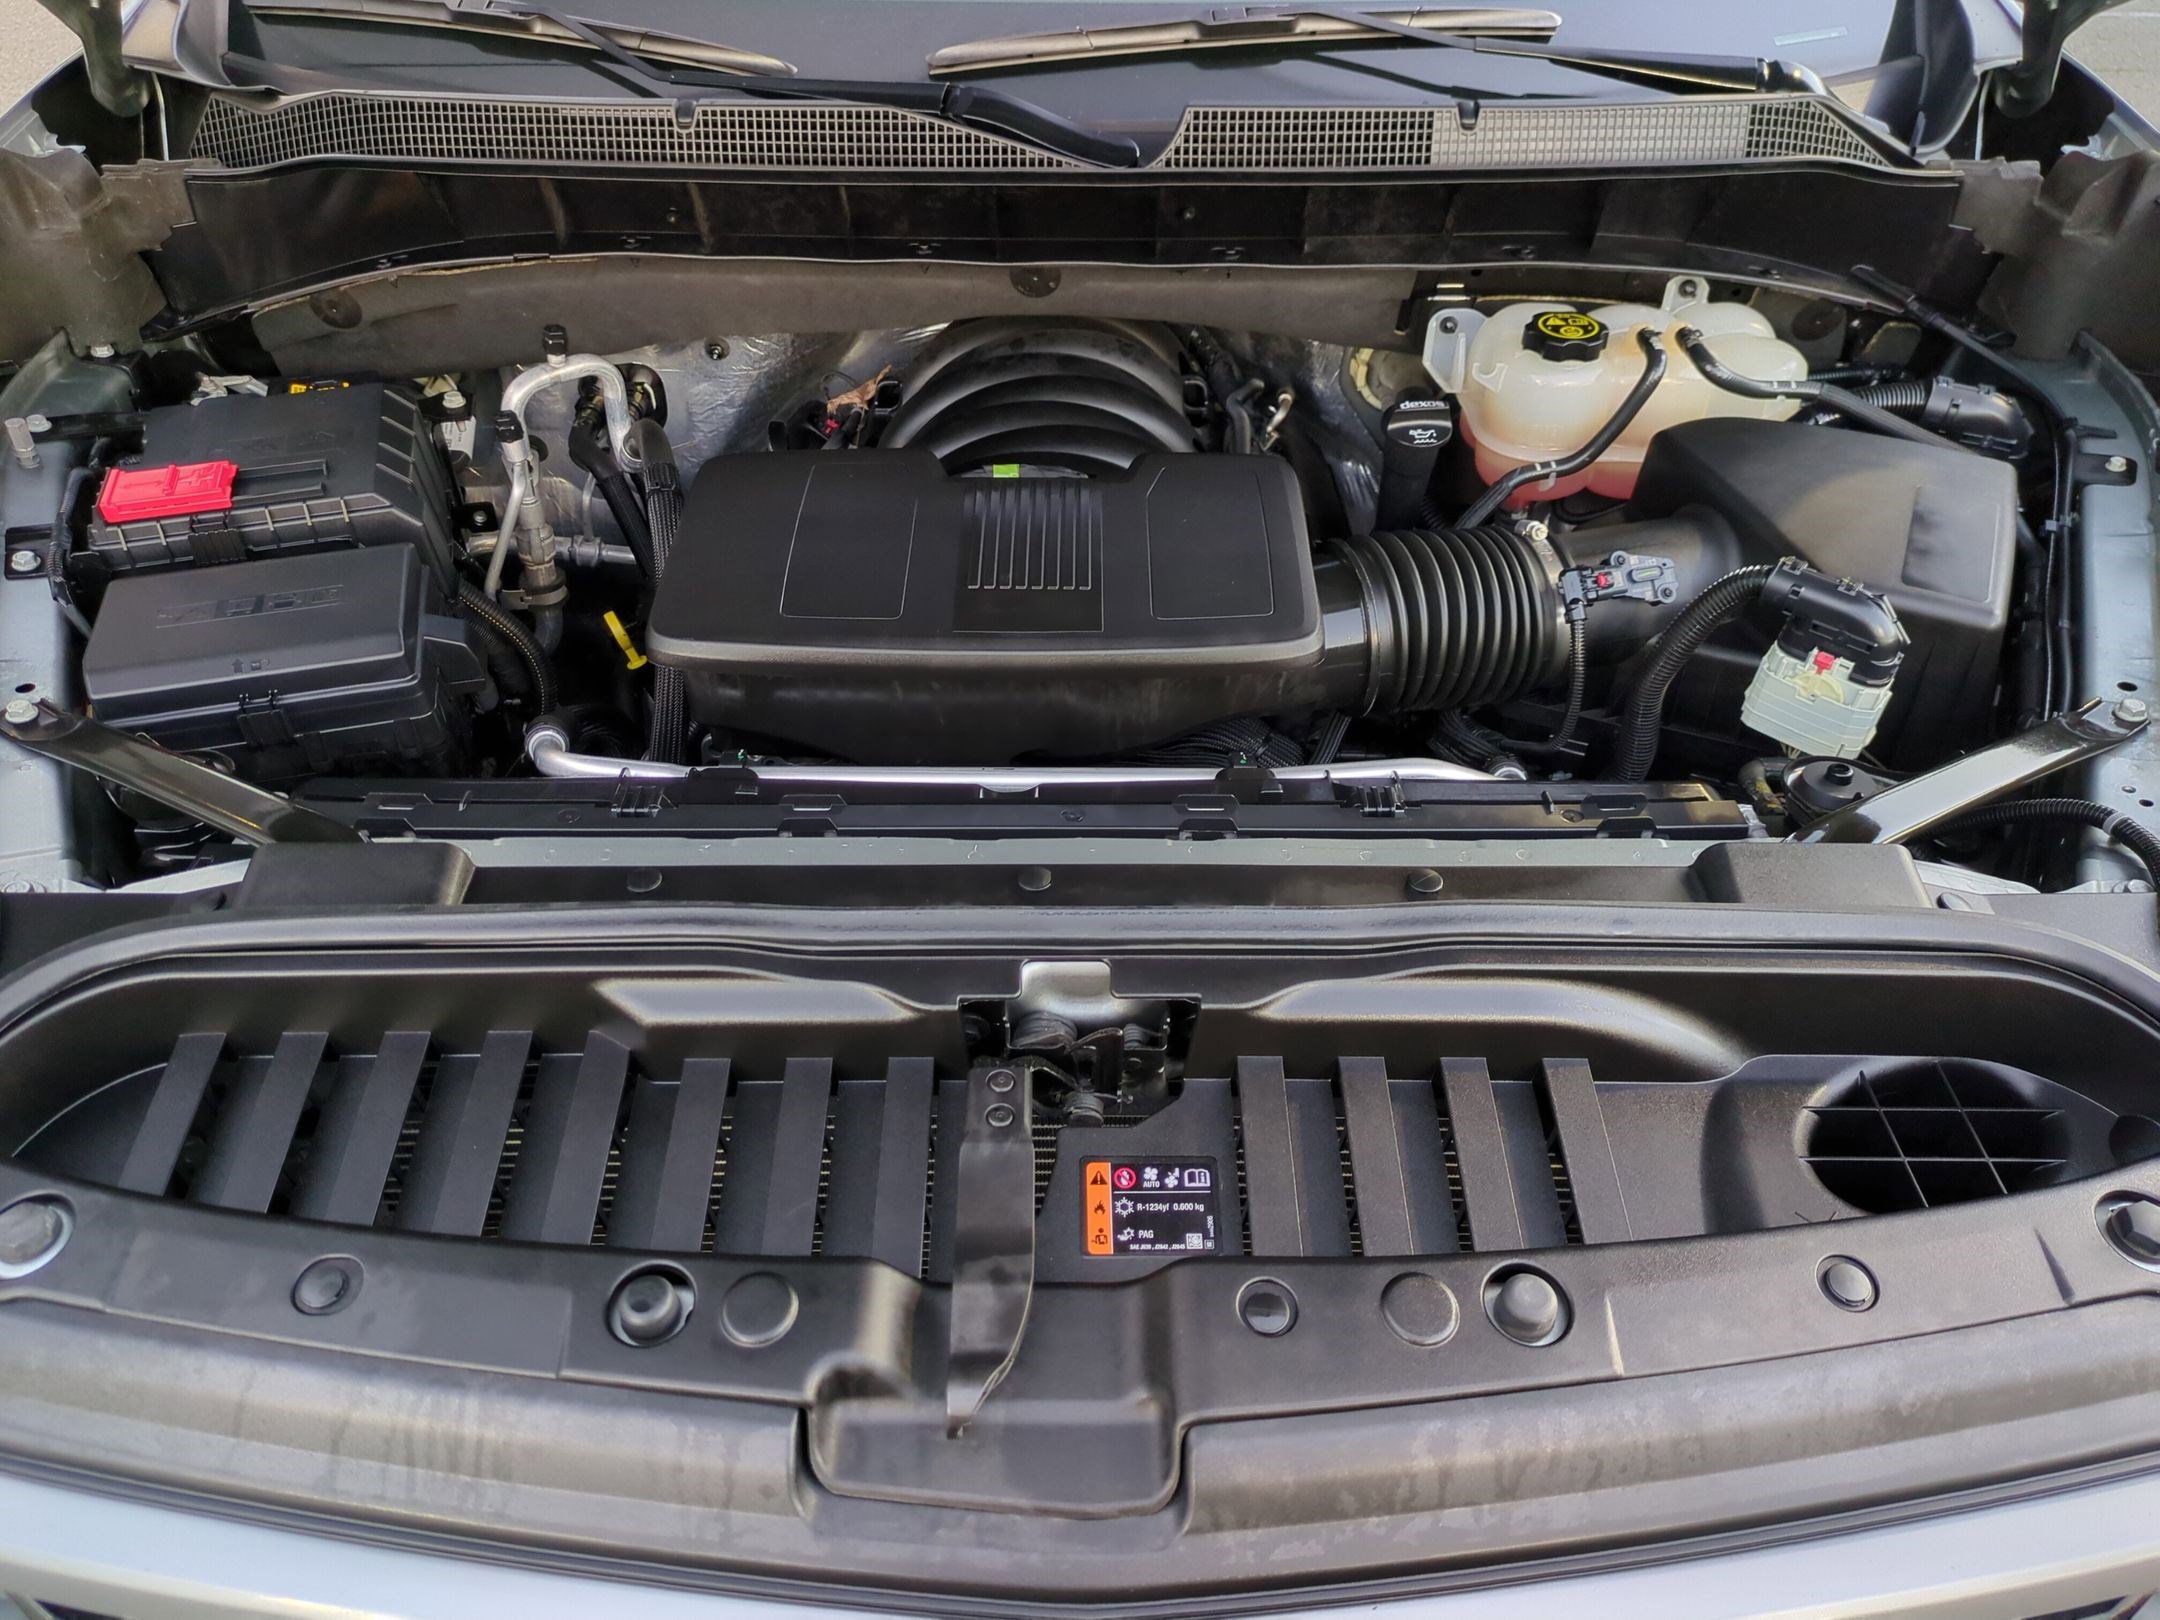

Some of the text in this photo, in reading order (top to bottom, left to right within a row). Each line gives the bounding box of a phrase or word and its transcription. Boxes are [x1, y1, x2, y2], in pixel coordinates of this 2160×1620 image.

[1137, 1203, 1170, 1212] R-1234yf
[1195, 1203, 1205, 1212] kg
[1138, 1230, 1154, 1239] PAG
